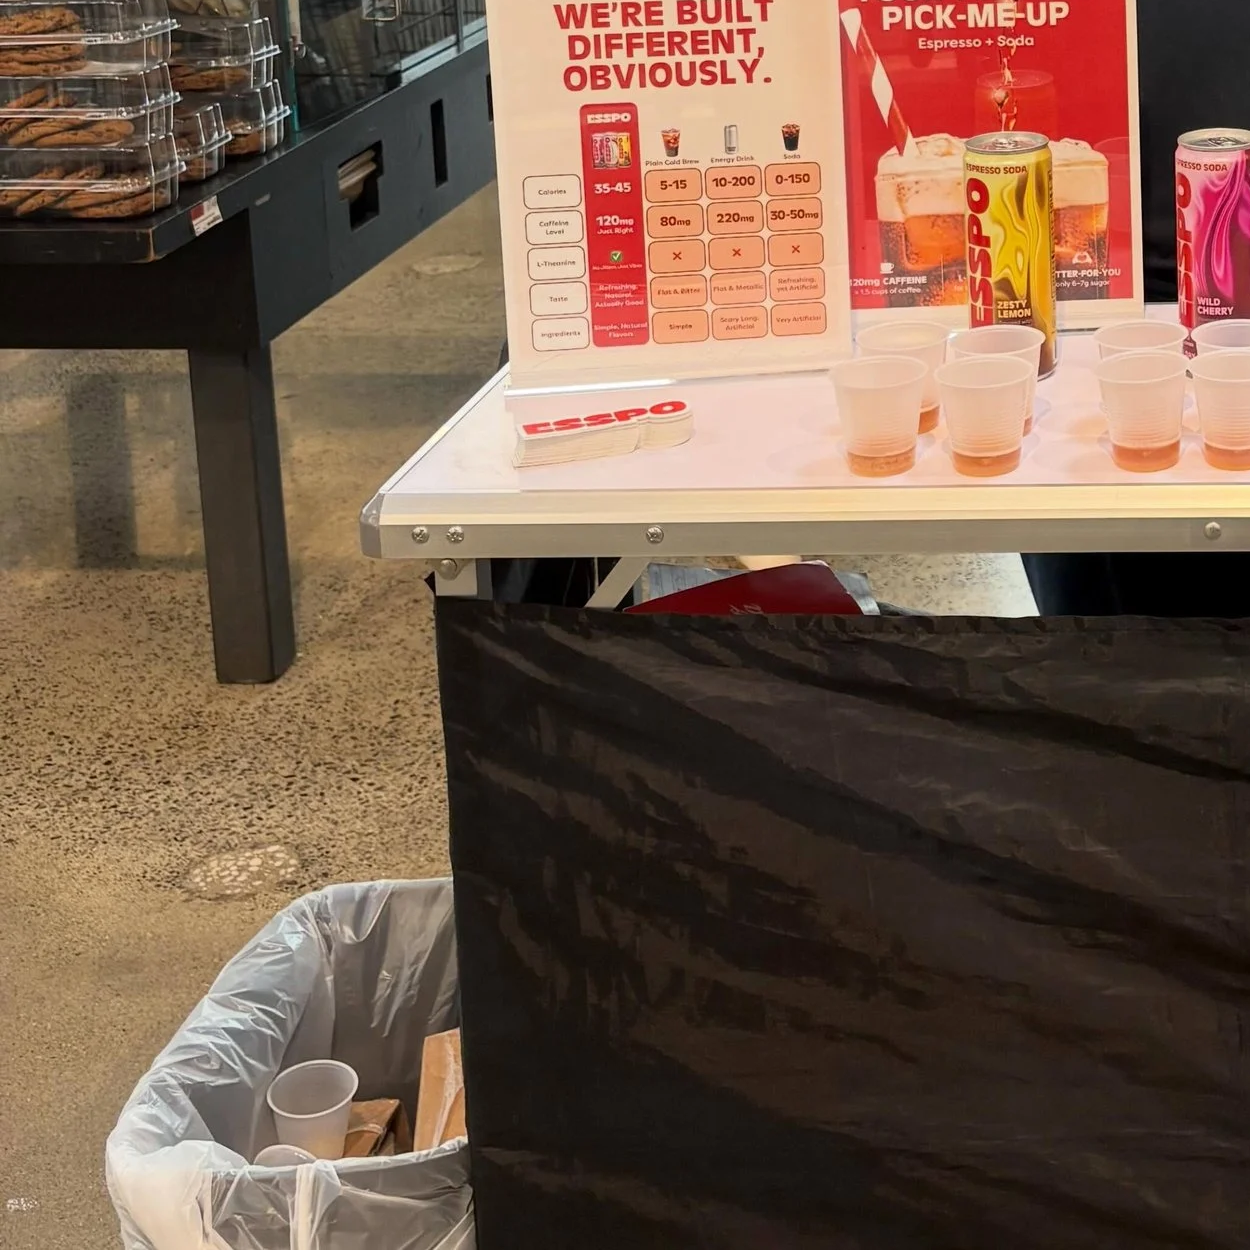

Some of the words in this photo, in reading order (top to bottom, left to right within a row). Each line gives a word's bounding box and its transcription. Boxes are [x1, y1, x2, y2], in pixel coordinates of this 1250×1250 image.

[553, 0, 664, 30] WE'RE
[882, 1, 1070, 31] PICK-ME-UP
[568, 28, 765, 61] DIFFERENT,
[918, 37, 982, 51] Espresso
[985, 38, 993, 46] +
[997, 35, 1034, 47] Soda
[563, 58, 772, 92] OBVIOUSLY.
[645, 159, 663, 167] Plain
[665, 158, 681, 166] Cold
[710, 156, 735, 165] Energy
[966, 163, 1000, 175] ESPRESSO
[1003, 165, 1027, 175] SODA
[1204, 163, 1228, 172] SODA
[660, 179, 687, 191] 5-15
[712, 175, 755, 188] 10-200
[775, 173, 811, 185] 0-150
[538, 188, 567, 196] Calories
[594, 182, 632, 194] 35-45
[716, 213, 754, 224] 220mg
[770, 209, 819, 220] 30-50mg
[539, 220, 569, 228] Caffeine
[596, 215, 634, 227] 120mg
[660, 216, 691, 228] 80mg
[966, 177, 995, 328] ESSPO
[1055, 268, 1121, 279] TTER-FOR-YOU
[883, 276, 927, 286] CAFFEINE
[998, 300, 1027, 309] ZESTY
[1198, 297, 1221, 306] WILD
[998, 308, 1031, 319] LEMON
[1197, 306, 1233, 316] CHERRY
[523, 400, 687, 436] ESSPO
